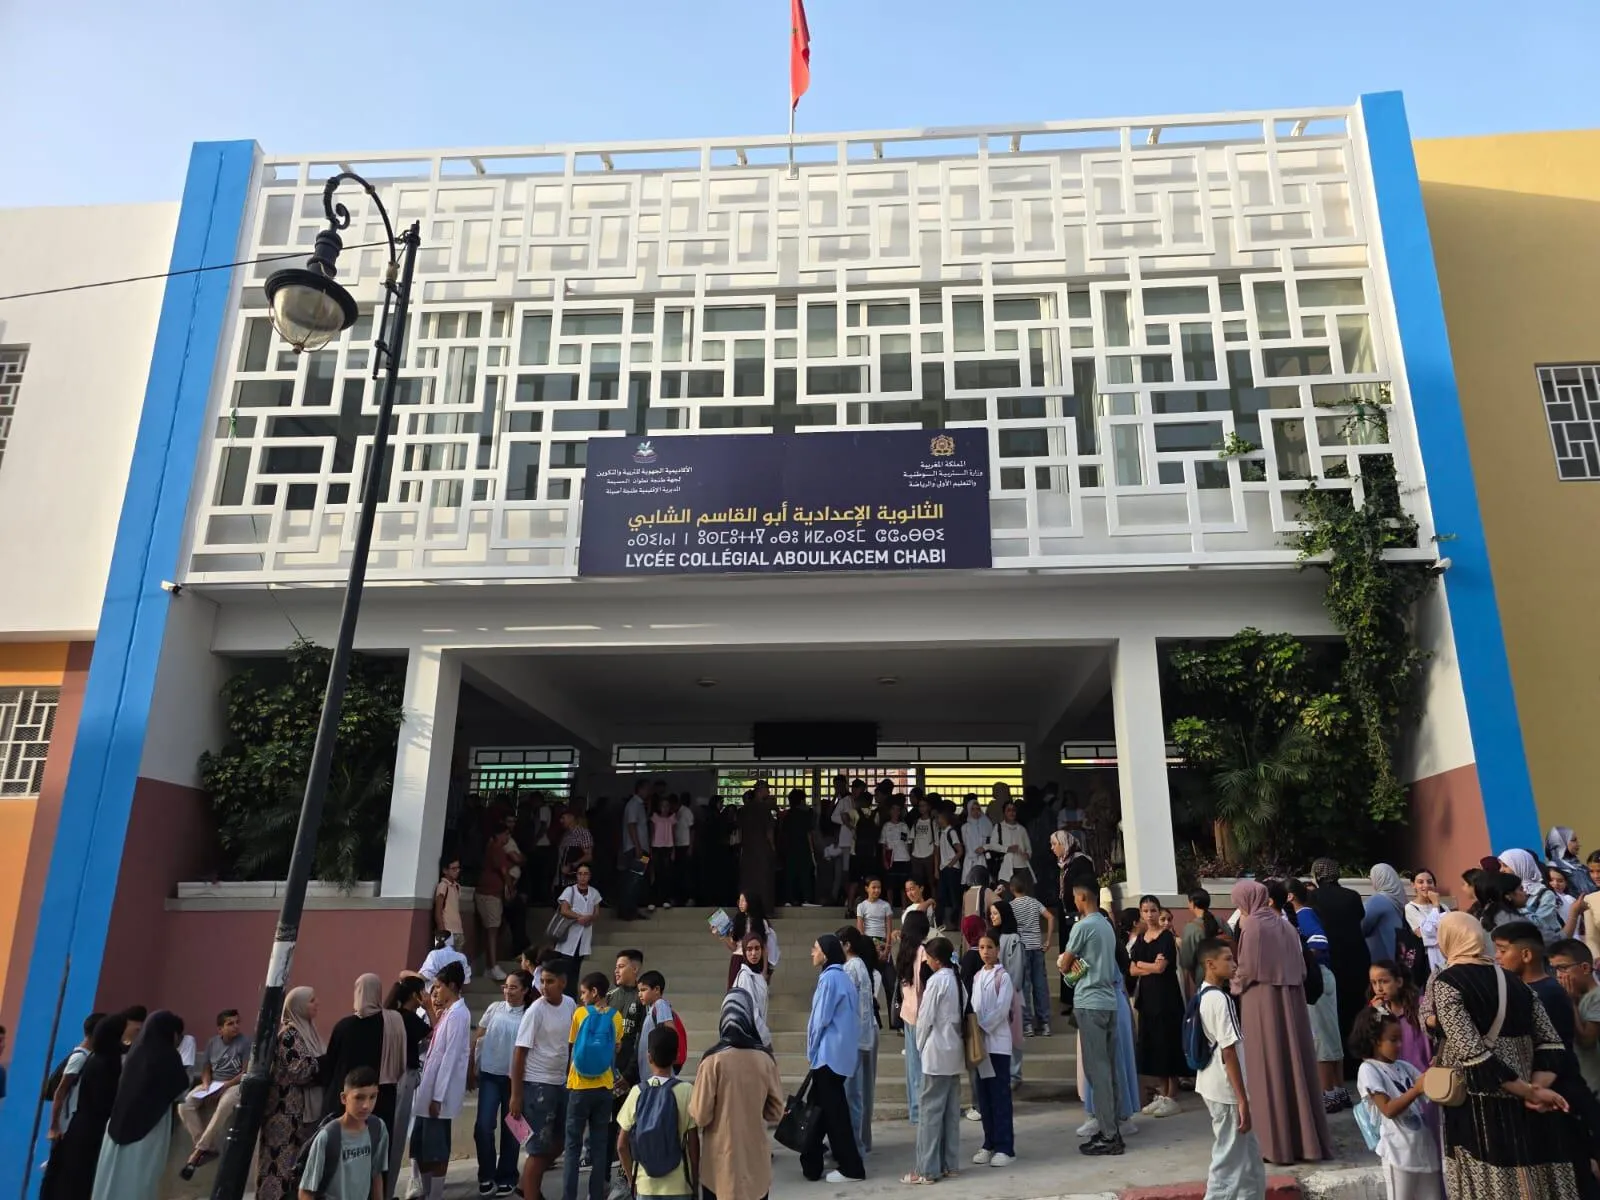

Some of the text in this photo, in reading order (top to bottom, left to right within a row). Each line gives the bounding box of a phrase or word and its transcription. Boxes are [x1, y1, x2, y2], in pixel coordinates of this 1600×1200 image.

[920, 461, 943, 469] المغربية
[628, 500, 944, 532] الثانوية الإعدادية أبو القاسم الشابي
[625, 548, 946, 568] LYCÉE COLLÉGIAL ABOULKACEM CHABI
